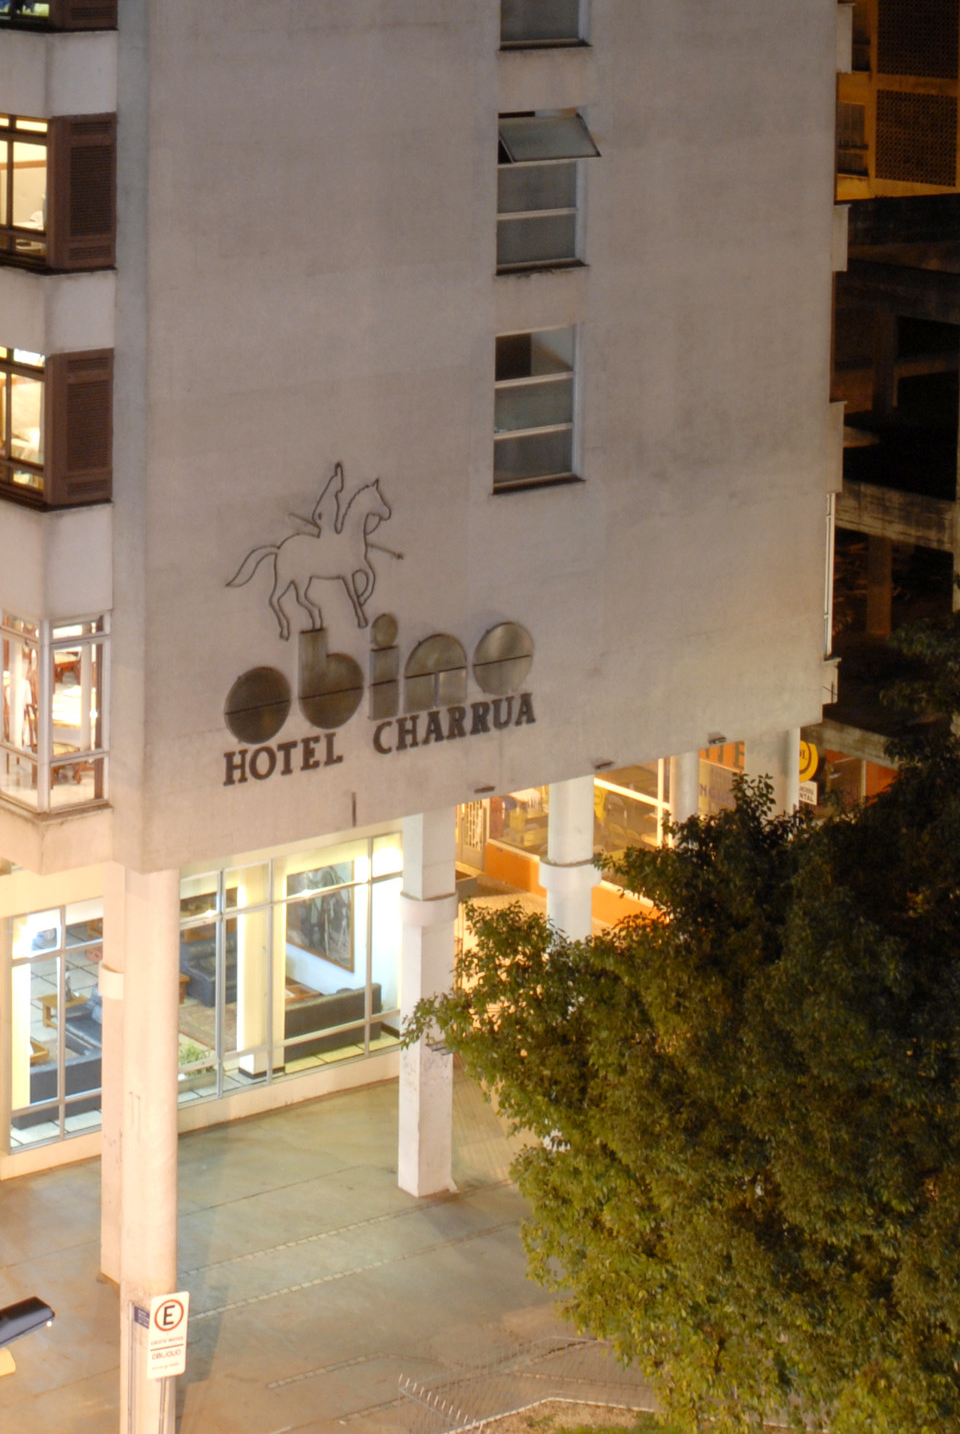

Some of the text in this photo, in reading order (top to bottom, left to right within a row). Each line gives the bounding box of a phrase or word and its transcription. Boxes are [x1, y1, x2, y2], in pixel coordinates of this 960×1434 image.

[223, 692, 537, 786] HOTEL CHARRUA
[162, 1304, 176, 1326] E
